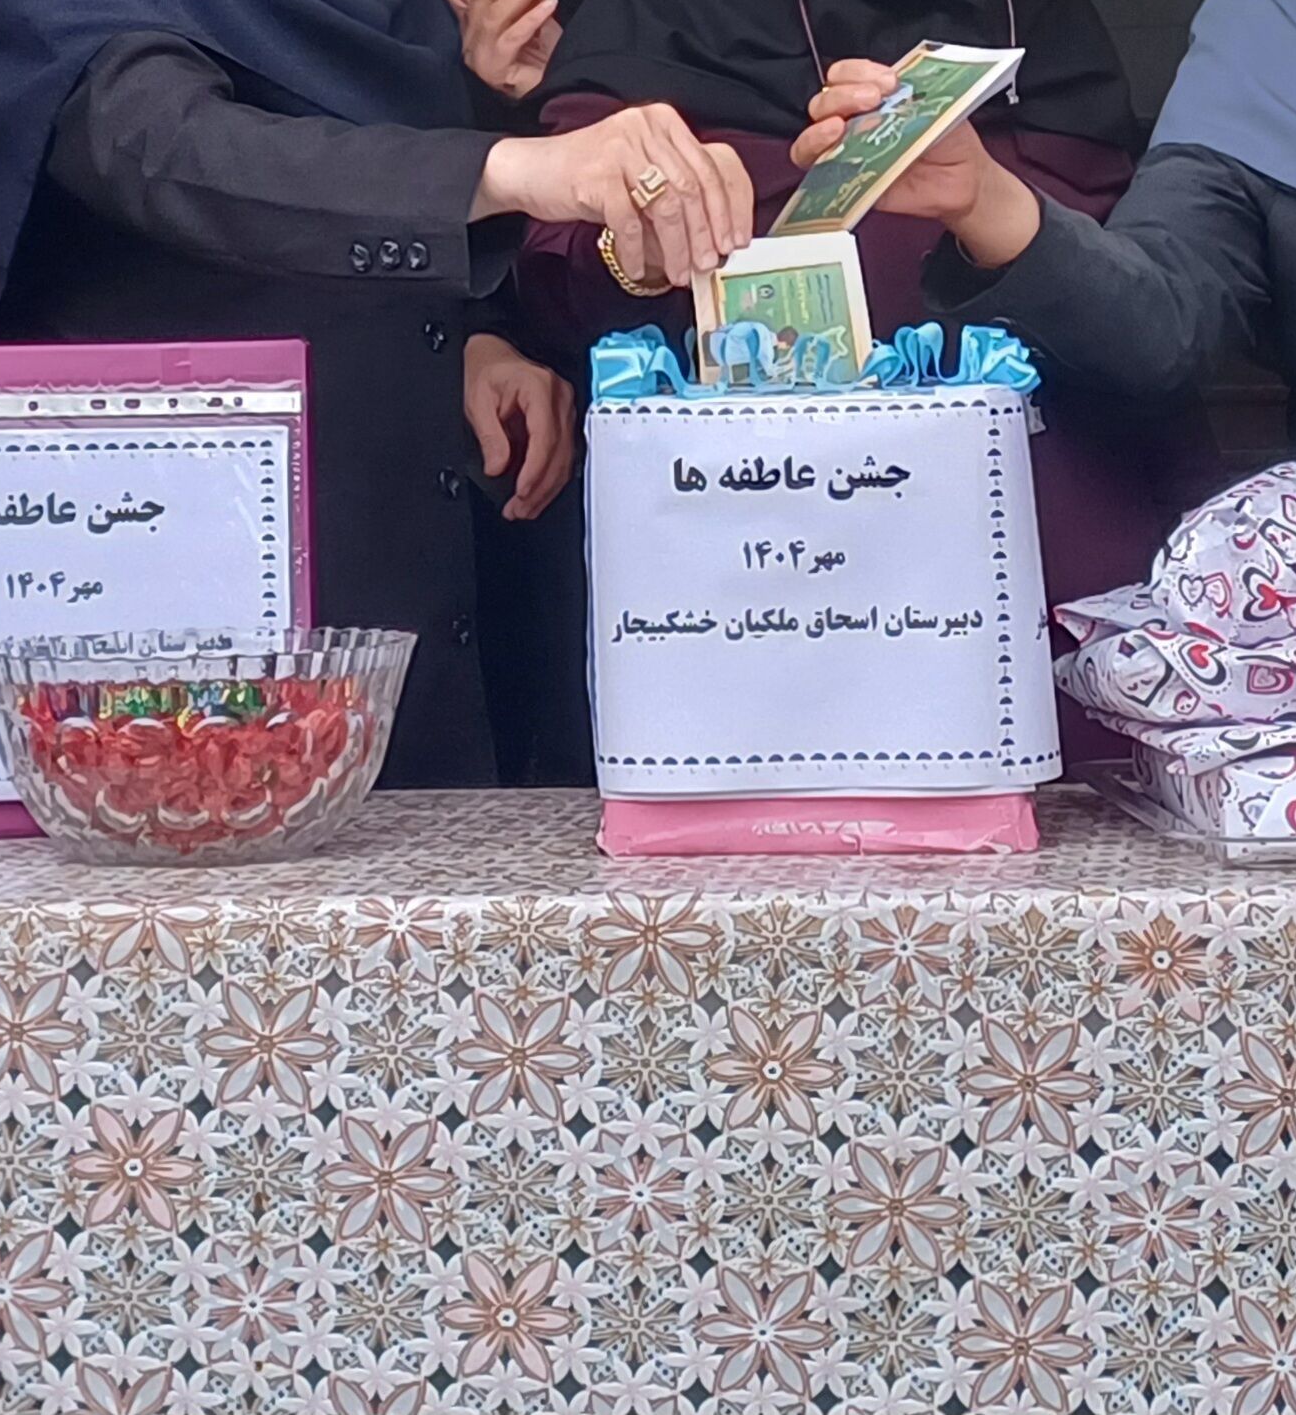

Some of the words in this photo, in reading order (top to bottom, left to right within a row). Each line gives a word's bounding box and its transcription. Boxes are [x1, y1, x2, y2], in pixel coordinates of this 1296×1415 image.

[673, 457, 708, 493] ها
[718, 455, 816, 492] عاطفه
[827, 455, 912, 501] جشن
[87, 491, 166, 535] جشن
[725, 607, 799, 641] ملکیان
[805, 605, 878, 639] اسحاق
[884, 605, 984, 638] دبیرستان
